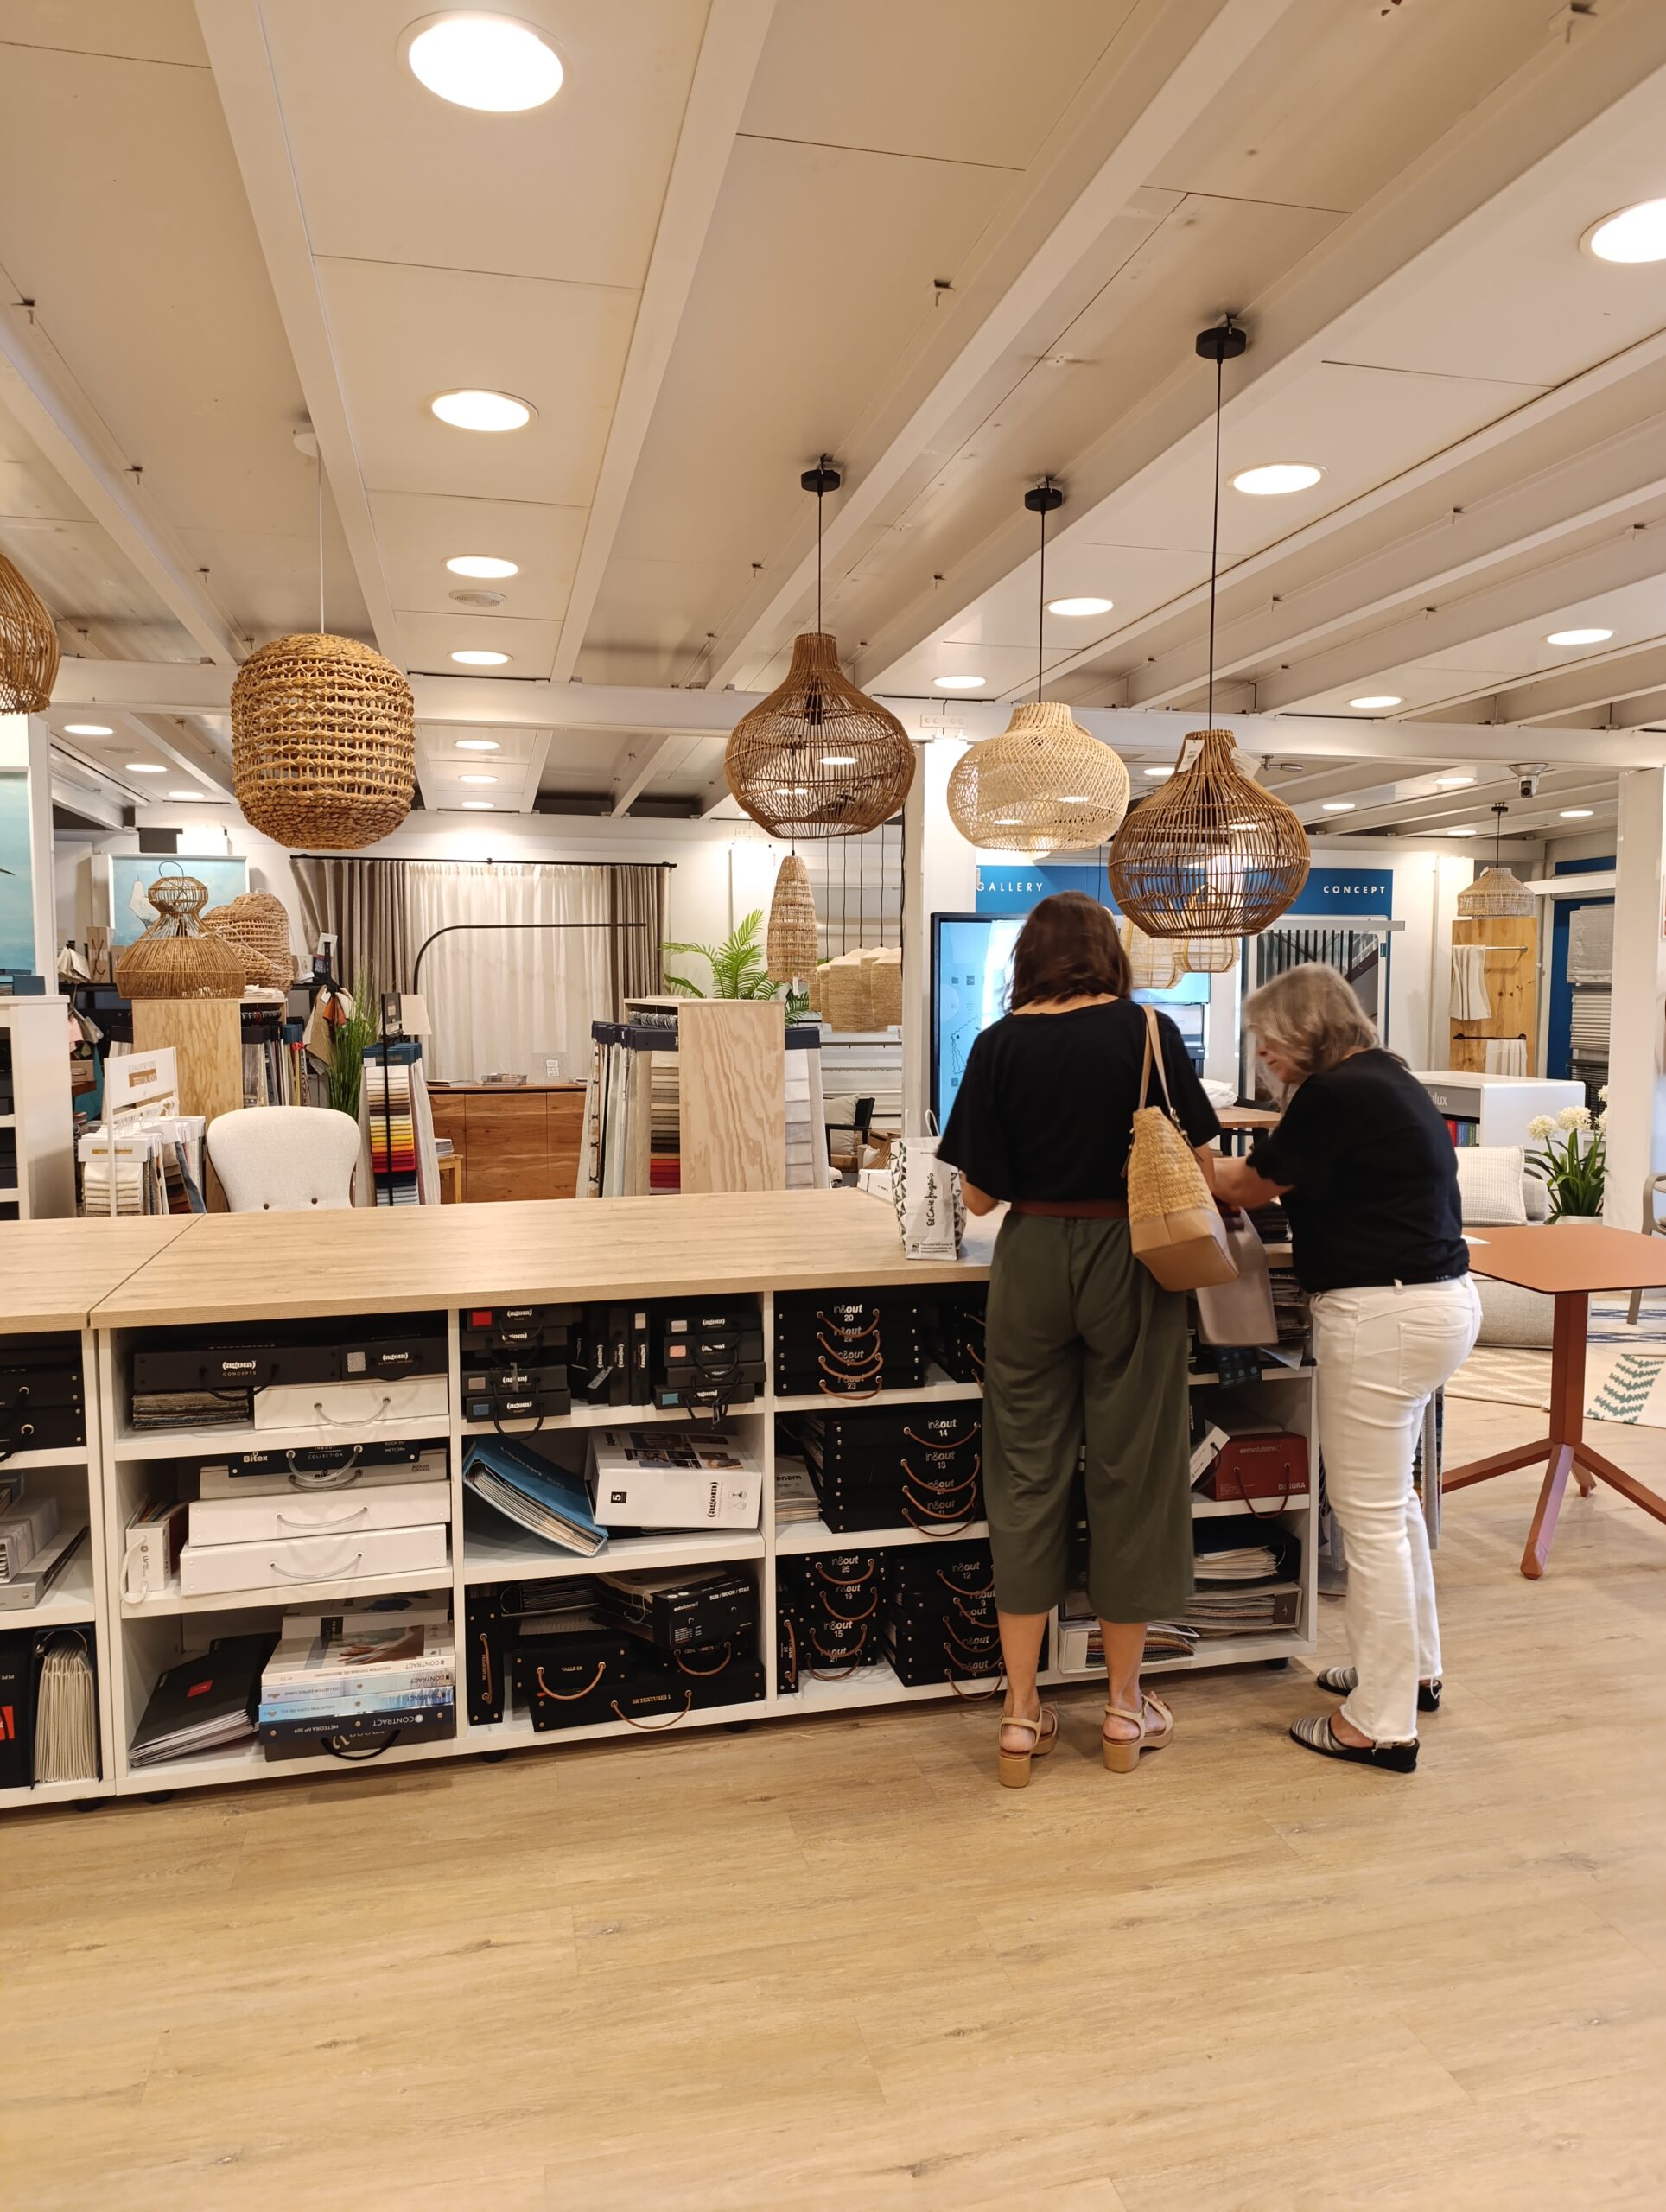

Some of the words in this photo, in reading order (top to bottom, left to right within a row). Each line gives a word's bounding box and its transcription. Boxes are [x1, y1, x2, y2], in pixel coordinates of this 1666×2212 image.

[976, 882, 1043, 892] GALLERY
[1323, 886, 1386, 894] CONCEPT
[833, 1304, 863, 1314] in&out
[222, 1360, 257, 1370] (agora)
[928, 1419, 957, 1429] in&out
[243, 1452, 268, 1463] Bitex
[926, 1451, 956, 1462] in&out
[707, 1481, 720, 1518] (agora)
[831, 1555, 859, 1566] in&out
[823, 1621, 854, 1630] in&out
[405, 1660, 440, 1669] CONTRACT
[639, 1695, 665, 1704] TEXTURES
[372, 1716, 415, 1726] CONTRACT
[312, 1724, 340, 1732] METEORA
